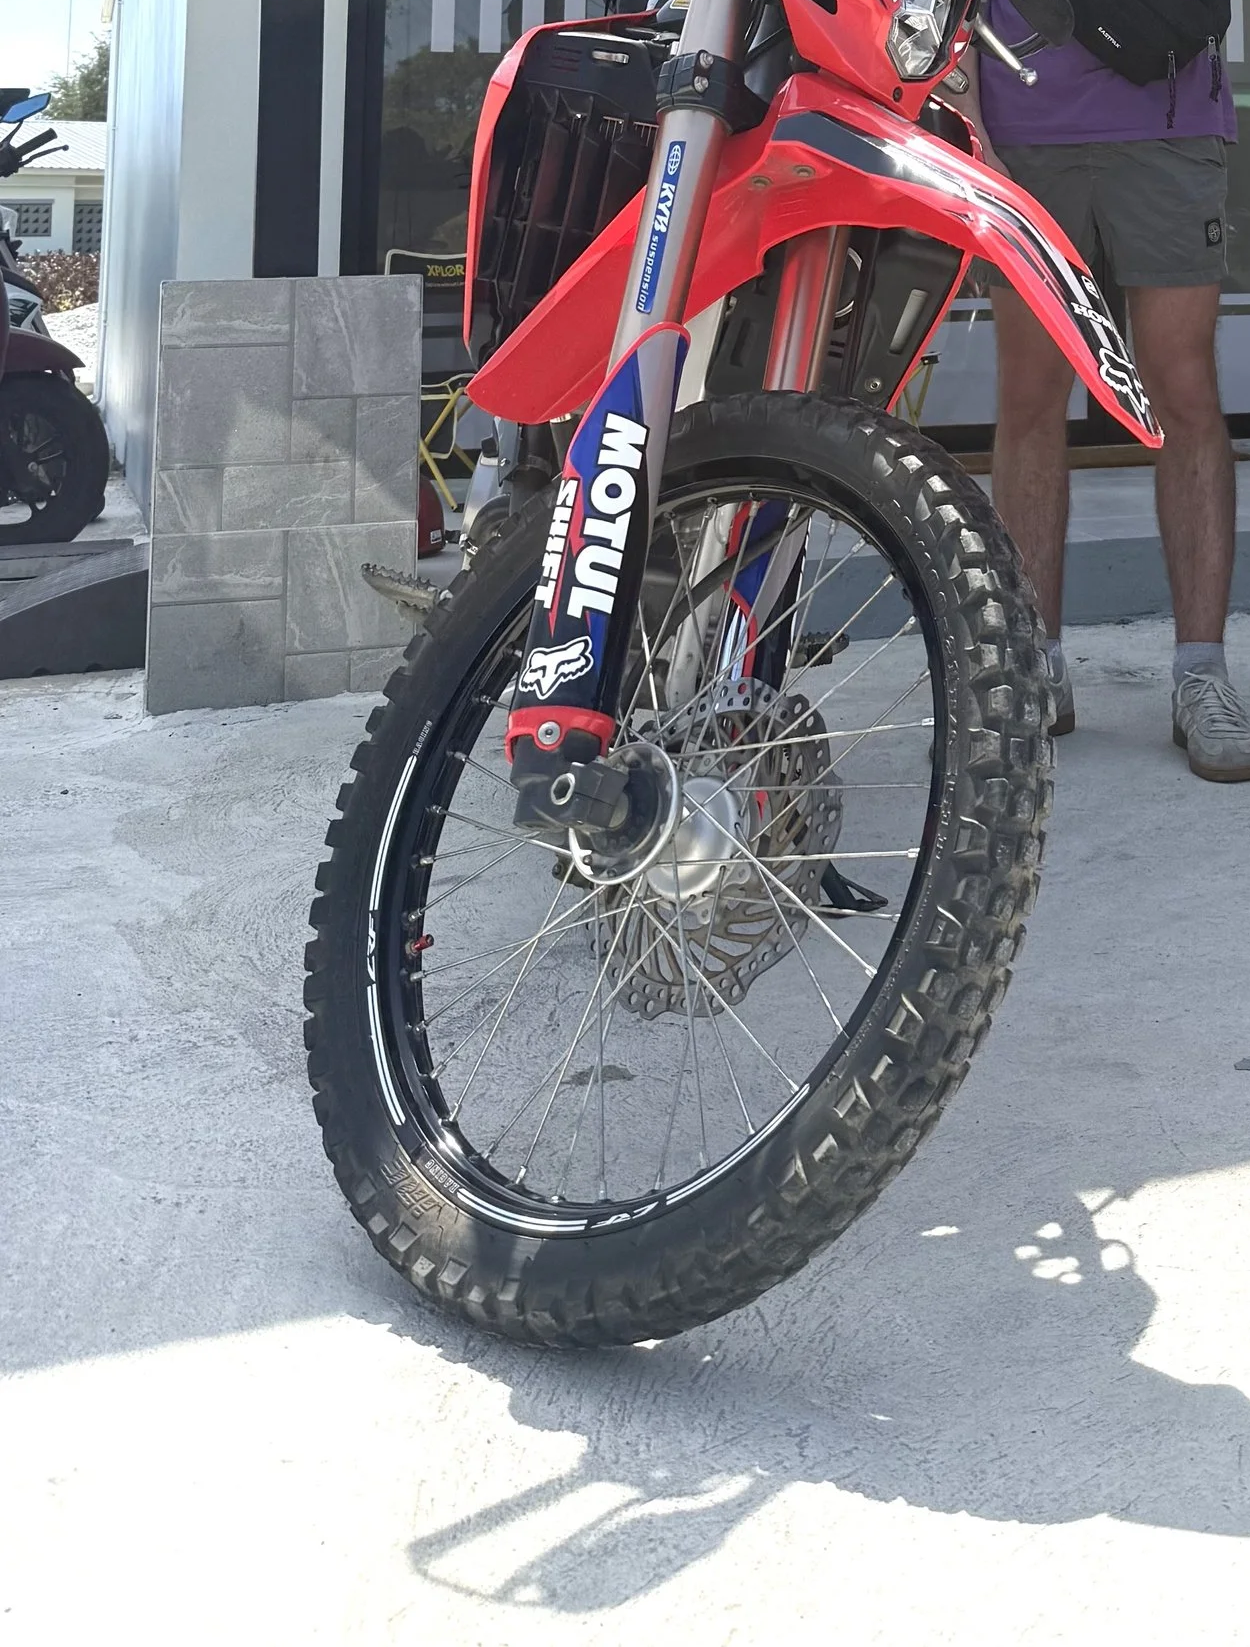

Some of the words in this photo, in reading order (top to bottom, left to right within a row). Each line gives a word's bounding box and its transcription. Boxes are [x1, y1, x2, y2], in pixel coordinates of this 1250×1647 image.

[653, 182, 676, 234] KYB
[637, 234, 659, 312] suspension
[534, 480, 578, 610] SHIFT
[566, 412, 647, 619] MOTUL
[413, 720, 433, 755] RACING
[424, 1158, 460, 1194] RACING
